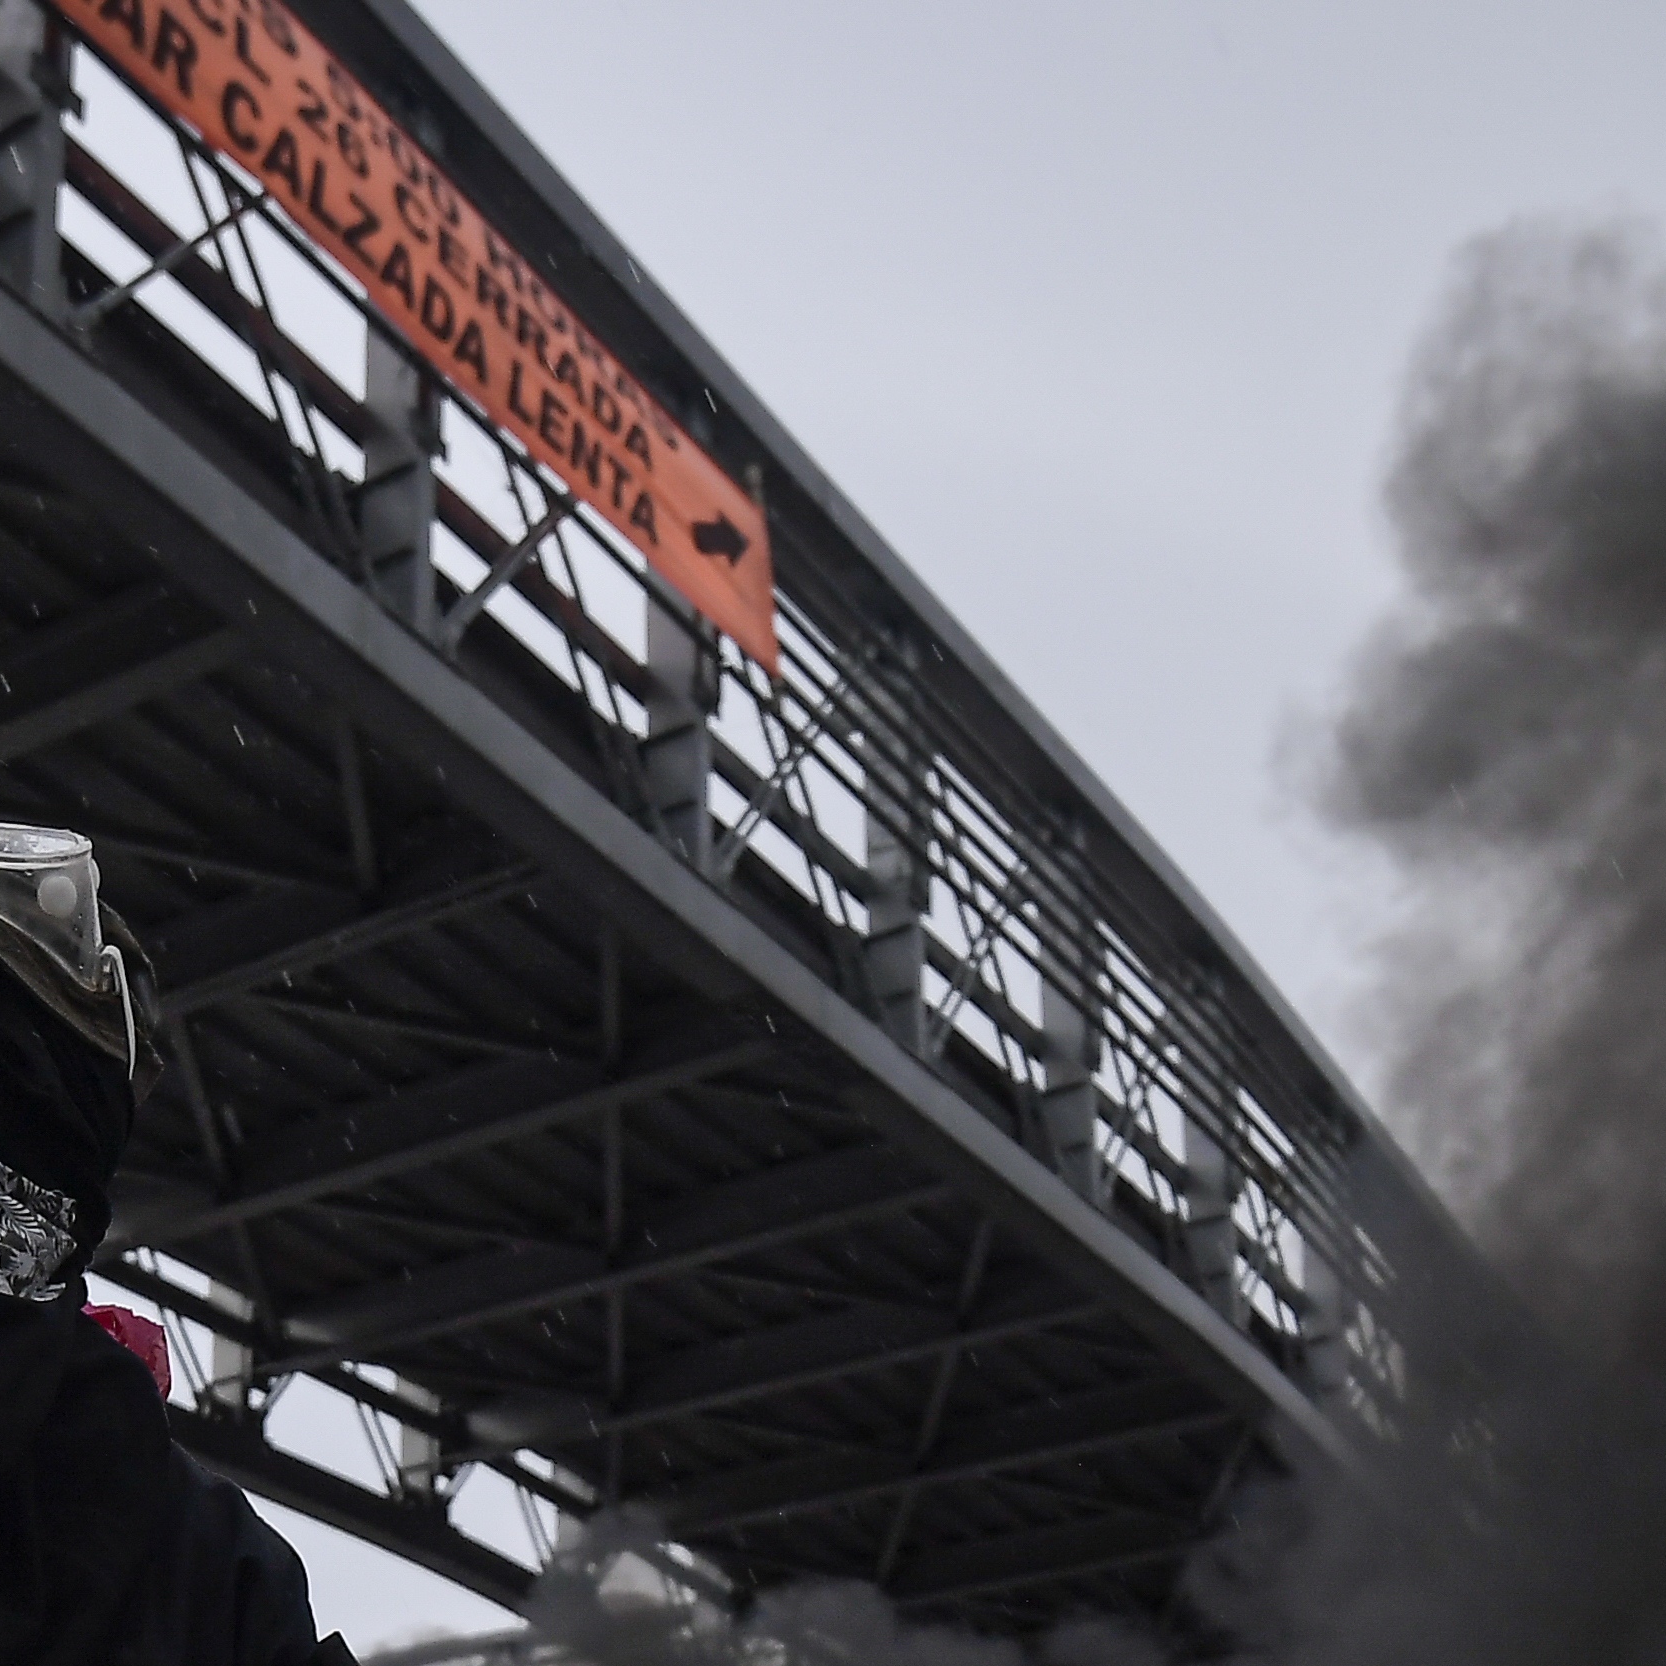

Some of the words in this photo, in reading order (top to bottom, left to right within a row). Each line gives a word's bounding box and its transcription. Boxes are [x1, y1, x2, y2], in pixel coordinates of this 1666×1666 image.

[220, 79, 489, 388] CALZADA
[507, 358, 660, 546] LENTA
[295, 78, 372, 180] 26
[394, 182, 654, 472] CERRADA
[483, 228, 679, 451] HORAS
